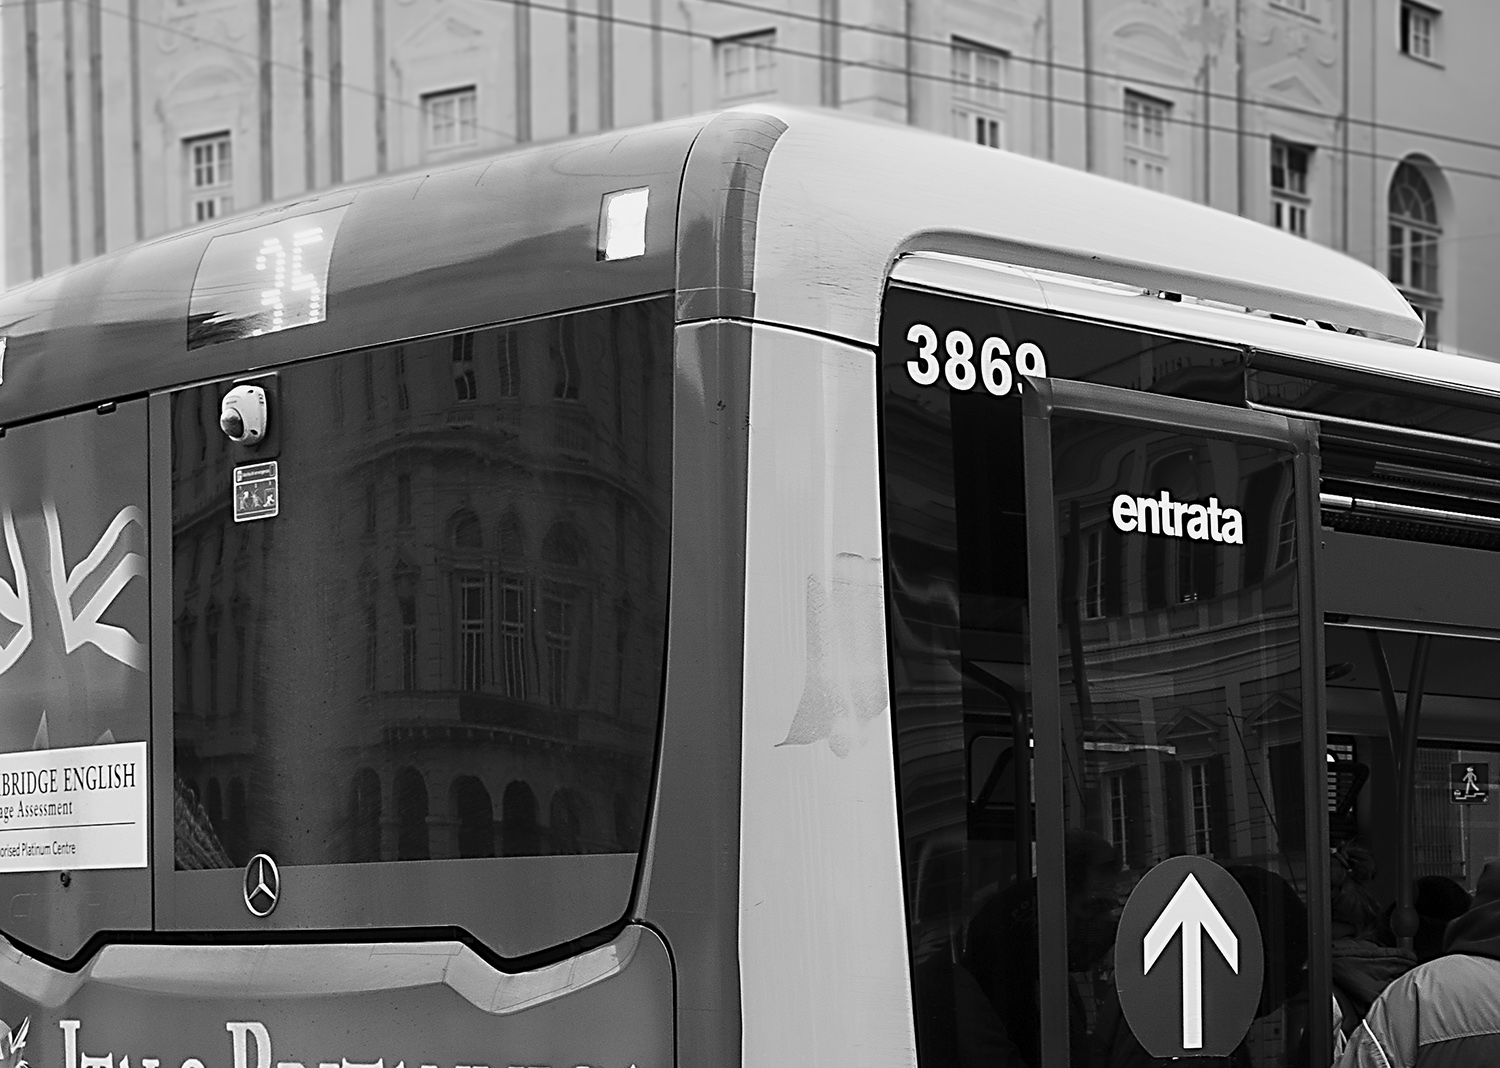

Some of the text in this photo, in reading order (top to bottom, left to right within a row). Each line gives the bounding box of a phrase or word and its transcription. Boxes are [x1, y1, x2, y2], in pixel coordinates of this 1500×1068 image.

[1111, 491, 1244, 545] entrata
[0, 762, 136, 797] BRIDGE ENGLISH
[17, 800, 73, 818] Assessment
[21, 842, 51, 857] Platinum
[52, 840, 76, 856] Centre
